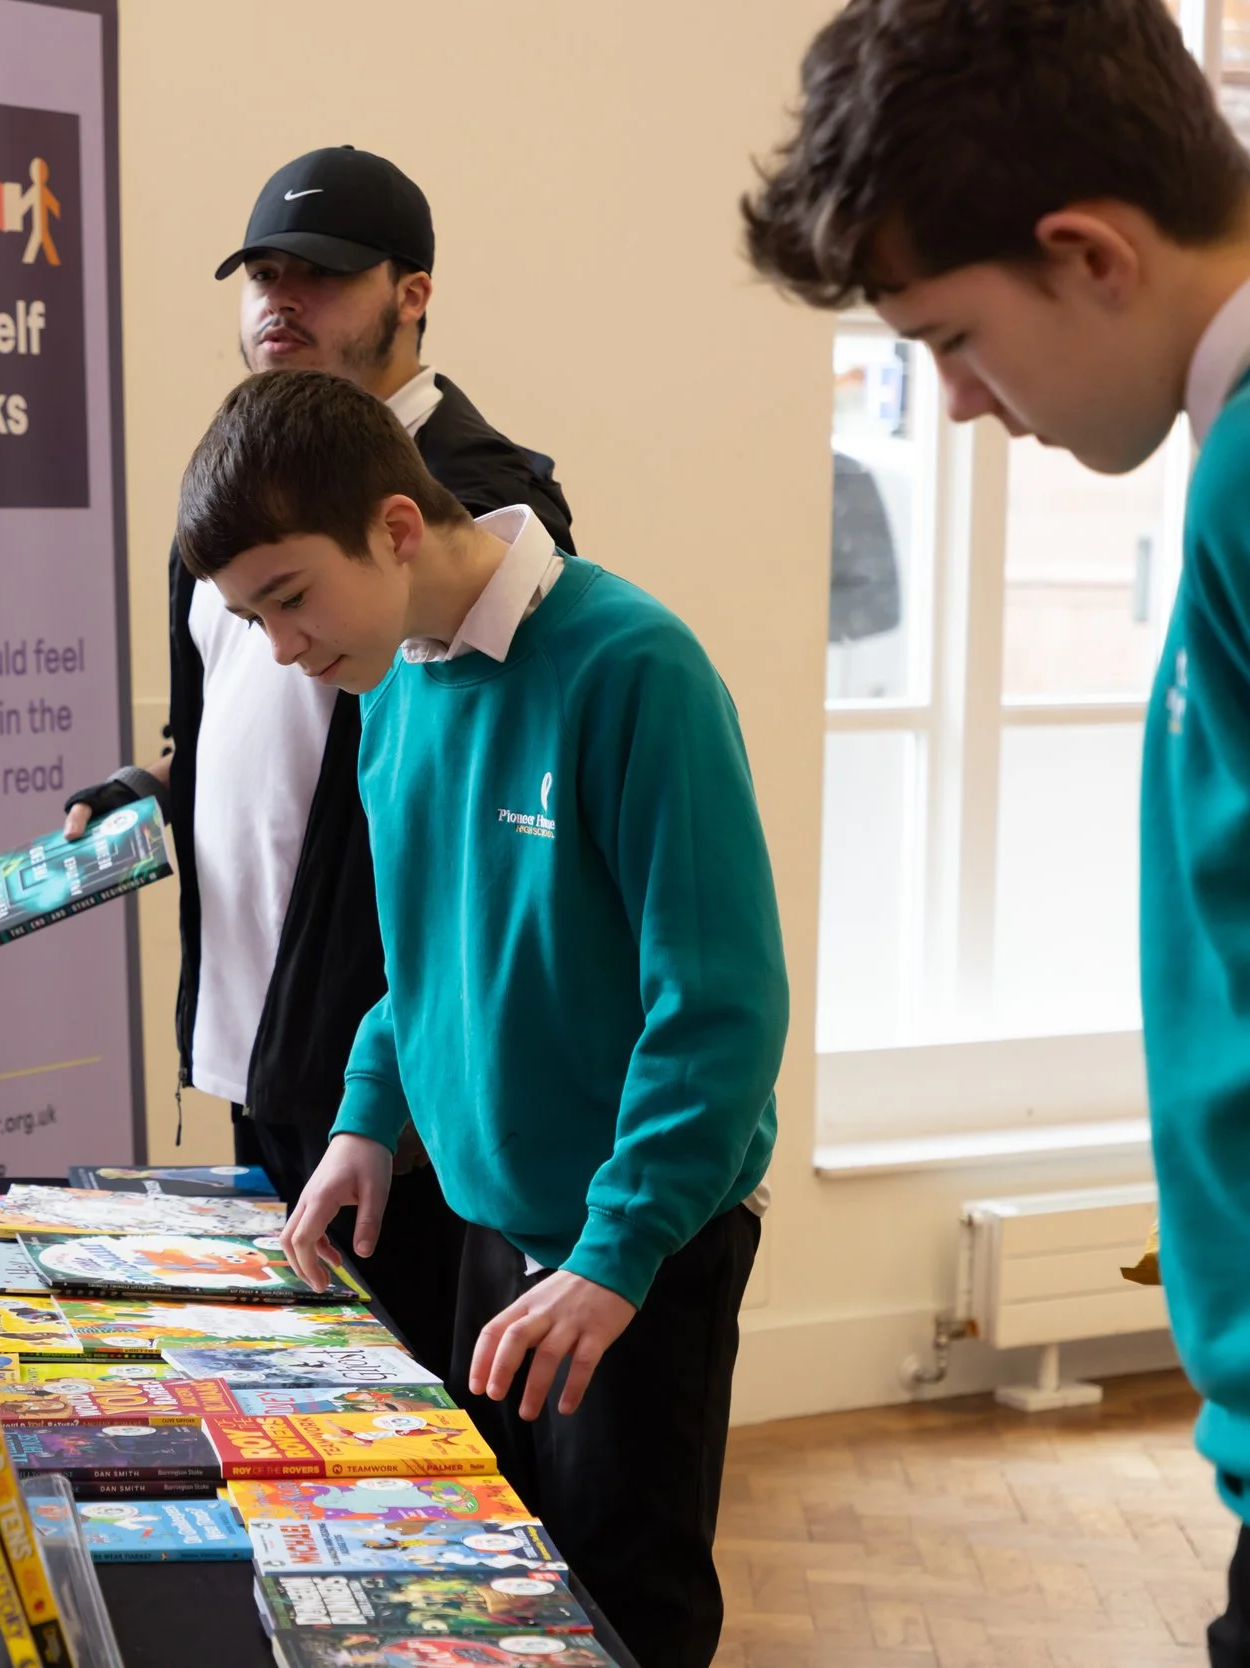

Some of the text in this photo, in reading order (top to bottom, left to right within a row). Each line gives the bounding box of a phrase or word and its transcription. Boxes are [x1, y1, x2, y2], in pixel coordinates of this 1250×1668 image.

[34, 637, 84, 675] feel
[28, 699, 72, 734] the
[2, 756, 64, 795] read
[498, 808, 535, 826] Pioneer
[9, 876, 146, 938] THE END AND OTHER BEGINNINGS
[315, 1349, 398, 1381] Ghost
[68, 1394, 101, 1417] WOULD
[91, 1385, 176, 1415] YOU
[189, 1381, 231, 1412] ROMANS
[216, 1417, 283, 1459] ROY OF
[232, 1416, 254, 1430] THE
[256, 1416, 312, 1459] ROVERS
[295, 1417, 342, 1457] TEAMWORK
[158, 1469, 188, 1477] Barrington
[232, 1465, 320, 1475] ROY OF THE ROVERS
[347, 1465, 399, 1473] TEAMWORK
[426, 1463, 464, 1472] PALMER
[164, 1483, 193, 1491] Barrington
[279, 1523, 322, 1565] MICHAEL
[312, 1575, 367, 1624] RUNNERS
